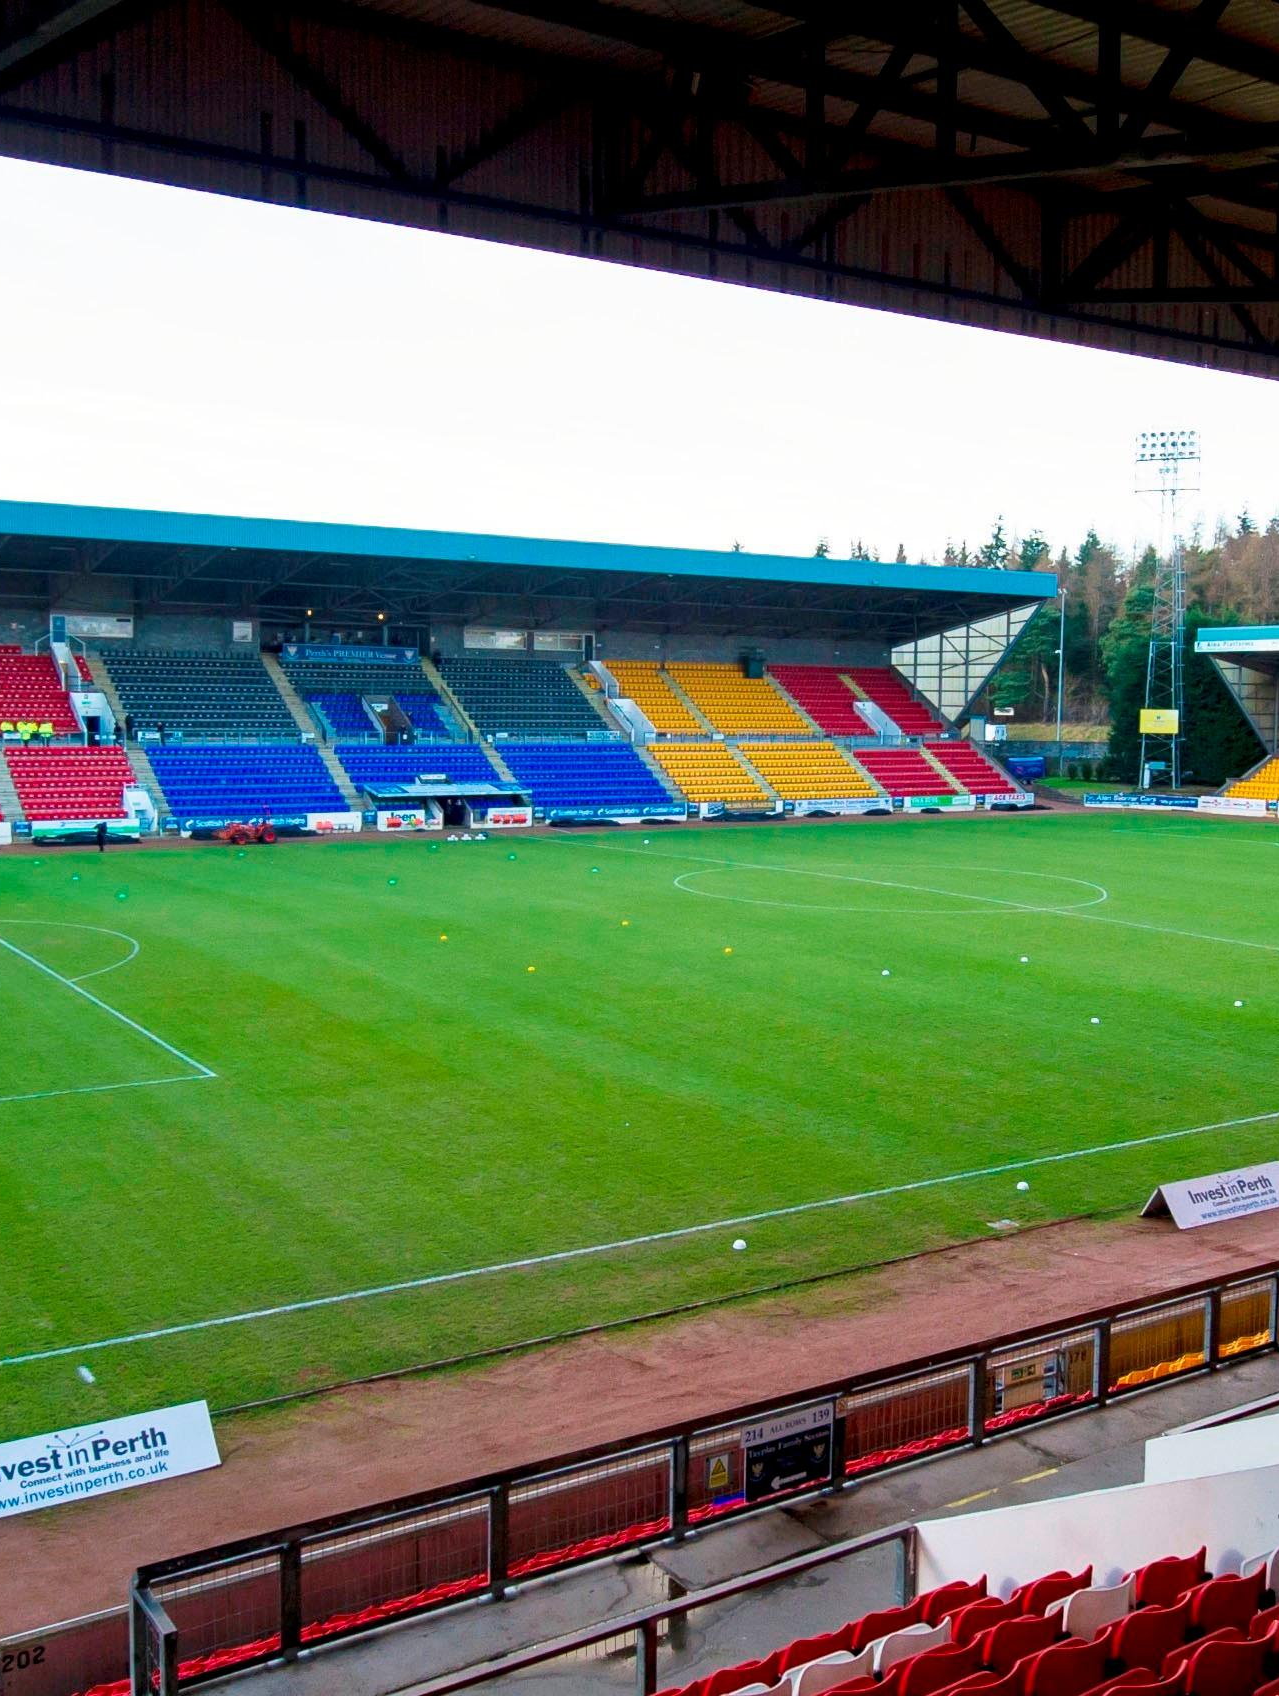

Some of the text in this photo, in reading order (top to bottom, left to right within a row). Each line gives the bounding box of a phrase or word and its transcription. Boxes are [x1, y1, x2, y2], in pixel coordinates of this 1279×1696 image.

[333, 650, 375, 658] PREMIER
[196, 819, 223, 828] Scottish
[285, 817, 306, 826] Hydro
[1187, 1175, 1273, 1205] Invest in Perth
[745, 1408, 830, 1443] 214 ALL ROWS 139
[67, 1446, 90, 1467] in
[91, 1427, 168, 1460] Perth
[20, 1447, 170, 1489] Connect with business and life
[1, 1645, 46, 1673] 202
